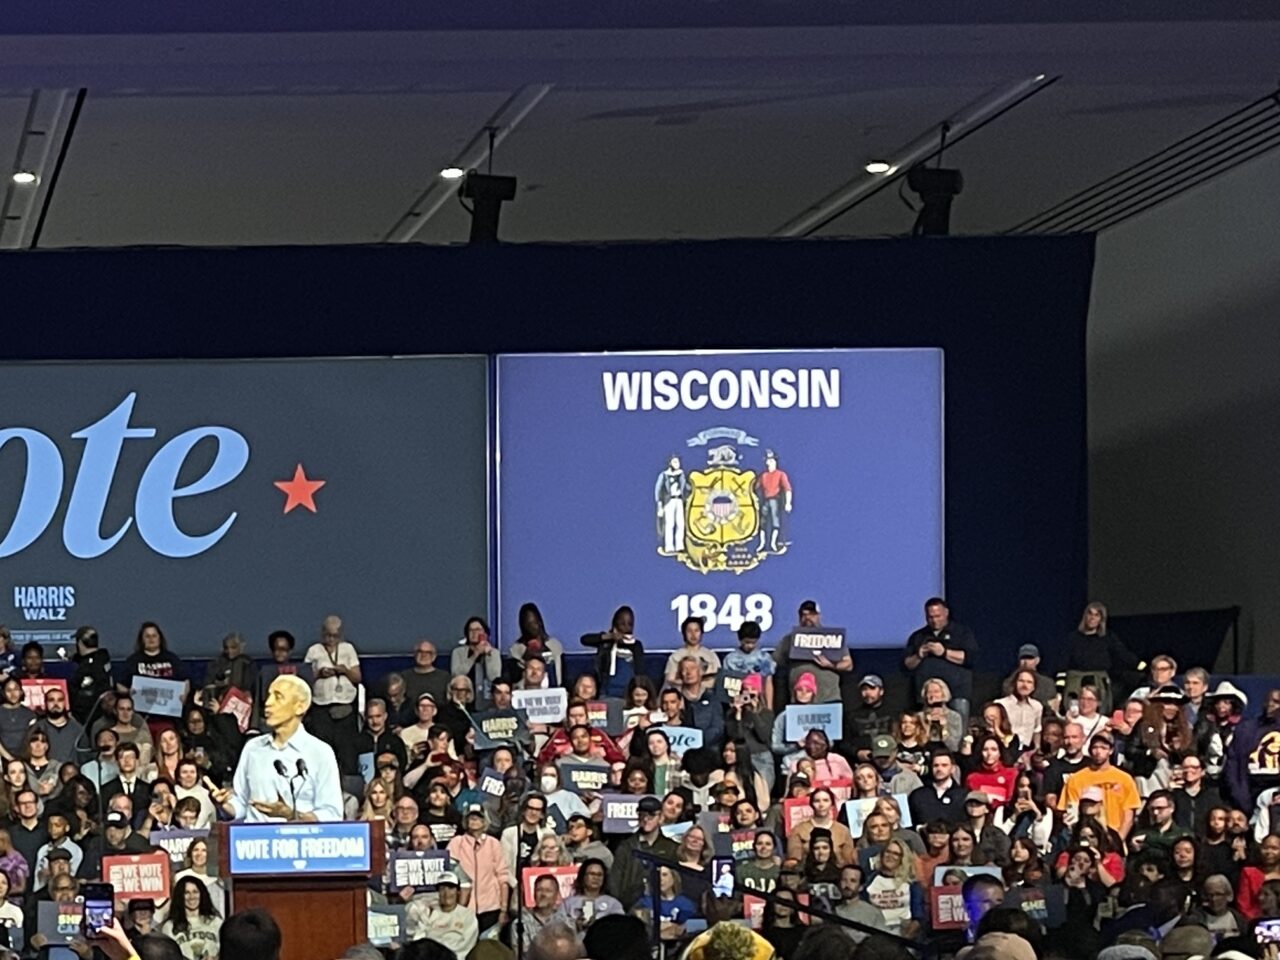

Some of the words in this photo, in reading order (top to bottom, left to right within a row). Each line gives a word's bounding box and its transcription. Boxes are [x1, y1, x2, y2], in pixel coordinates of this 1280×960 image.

[602, 368, 841, 411] WISCONSIN
[14, 586, 75, 608] HARRIS
[23, 608, 66, 621] WALZ
[671, 593, 773, 632] 1848
[794, 633, 843, 648] FREEDOM
[482, 717, 518, 733] HARRIS
[797, 713, 831, 725] HARRIS
[489, 730, 514, 739] WALZ
[668, 731, 696, 747] ote
[572, 770, 608, 784] HARRIS
[235, 838, 270, 860] VOTE
[271, 838, 299, 859] FOR
[301, 837, 365, 858] FREEDOM
[122, 864, 138, 878] WE
[139, 863, 163, 877] VOTE
[123, 878, 140, 892] WE
[140, 877, 163, 891] WIN
